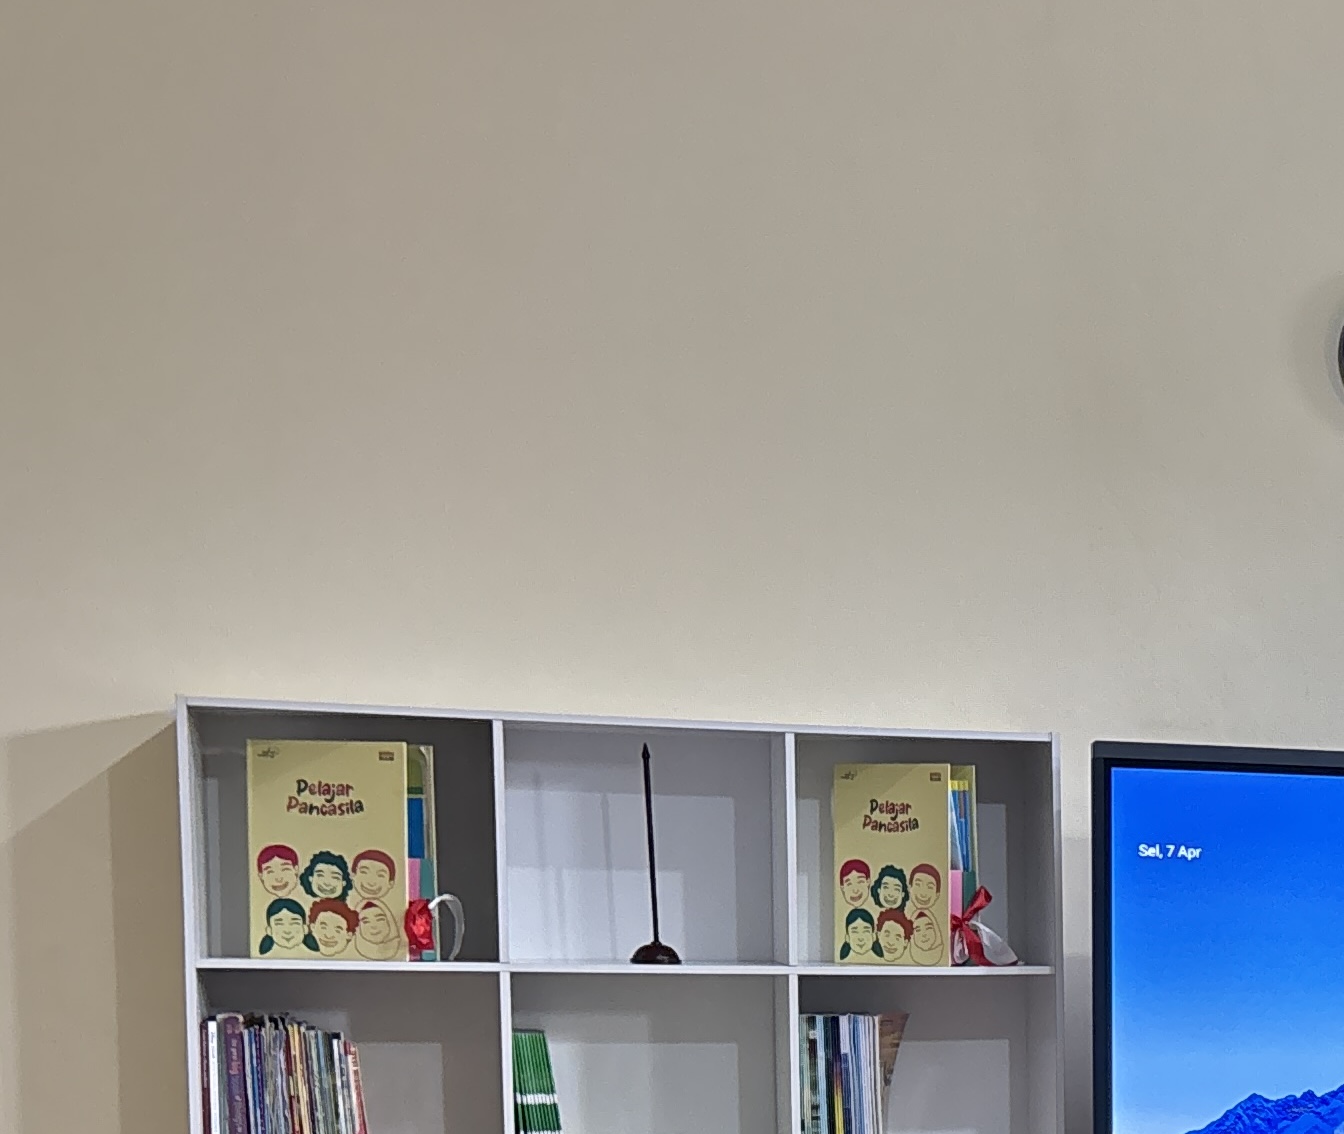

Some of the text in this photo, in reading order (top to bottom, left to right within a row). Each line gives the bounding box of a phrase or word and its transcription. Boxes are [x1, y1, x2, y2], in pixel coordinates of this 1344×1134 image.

[296, 779, 354, 803] Pelajar
[286, 796, 365, 816] Pancasila
[870, 799, 912, 821] Pelajar
[863, 814, 919, 833] Pancasila
[1138, 843, 1202, 861] Sel, 7 Apr
